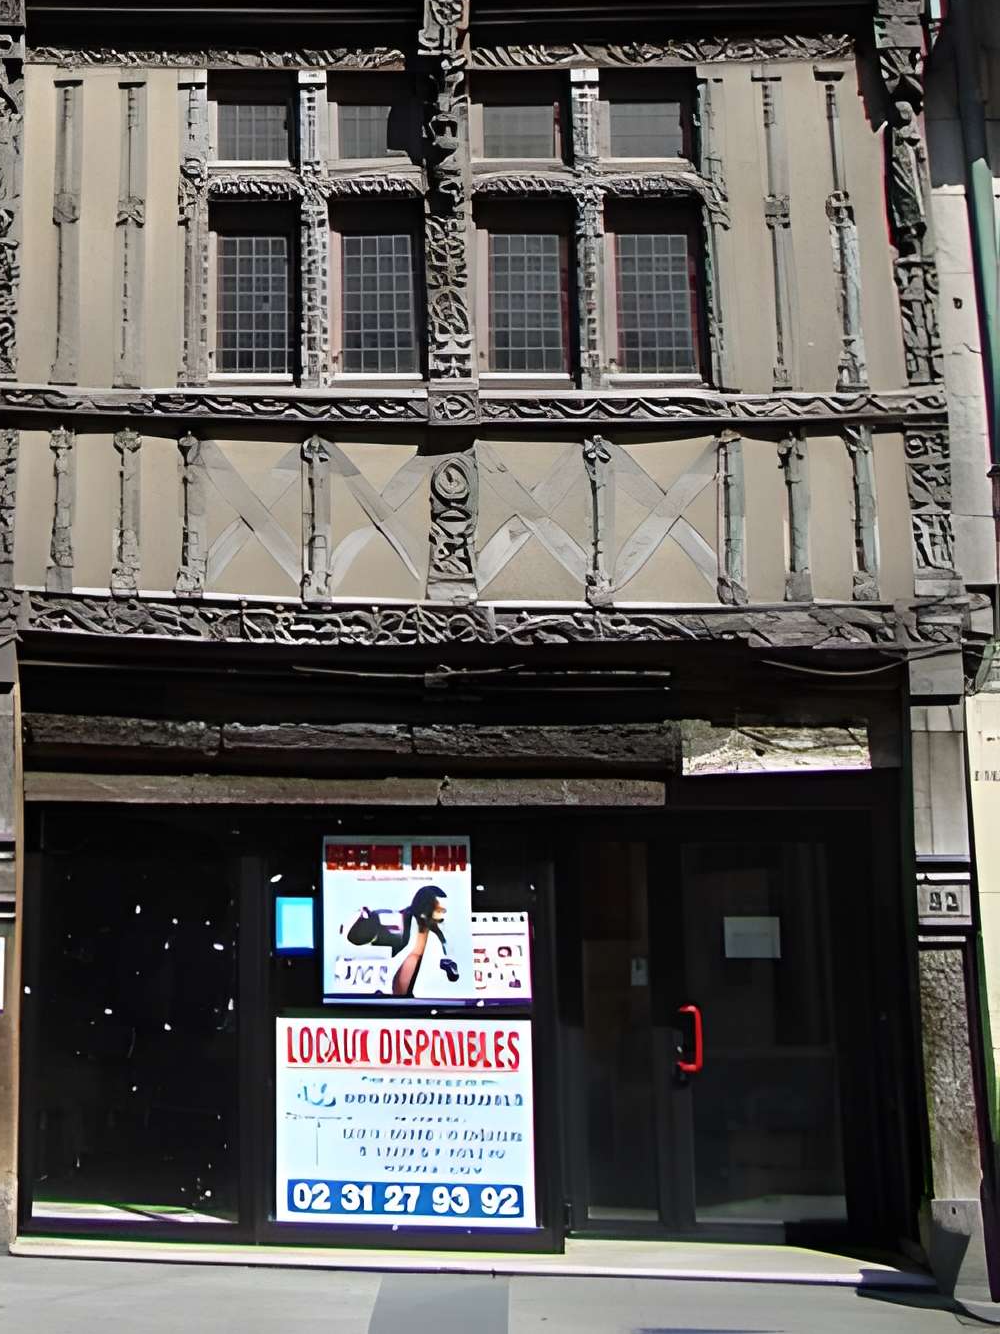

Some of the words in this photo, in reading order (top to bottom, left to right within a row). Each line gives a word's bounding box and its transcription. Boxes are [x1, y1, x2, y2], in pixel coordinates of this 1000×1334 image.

[287, 1026, 371, 1064] LOCAUX
[379, 1028, 520, 1069] DISPONIBLES
[293, 1182, 332, 1211] 02
[340, 1183, 373, 1212] 31
[384, 1184, 421, 1213] 27
[432, 1185, 470, 1214] 93
[480, 1186, 520, 1215] 92
